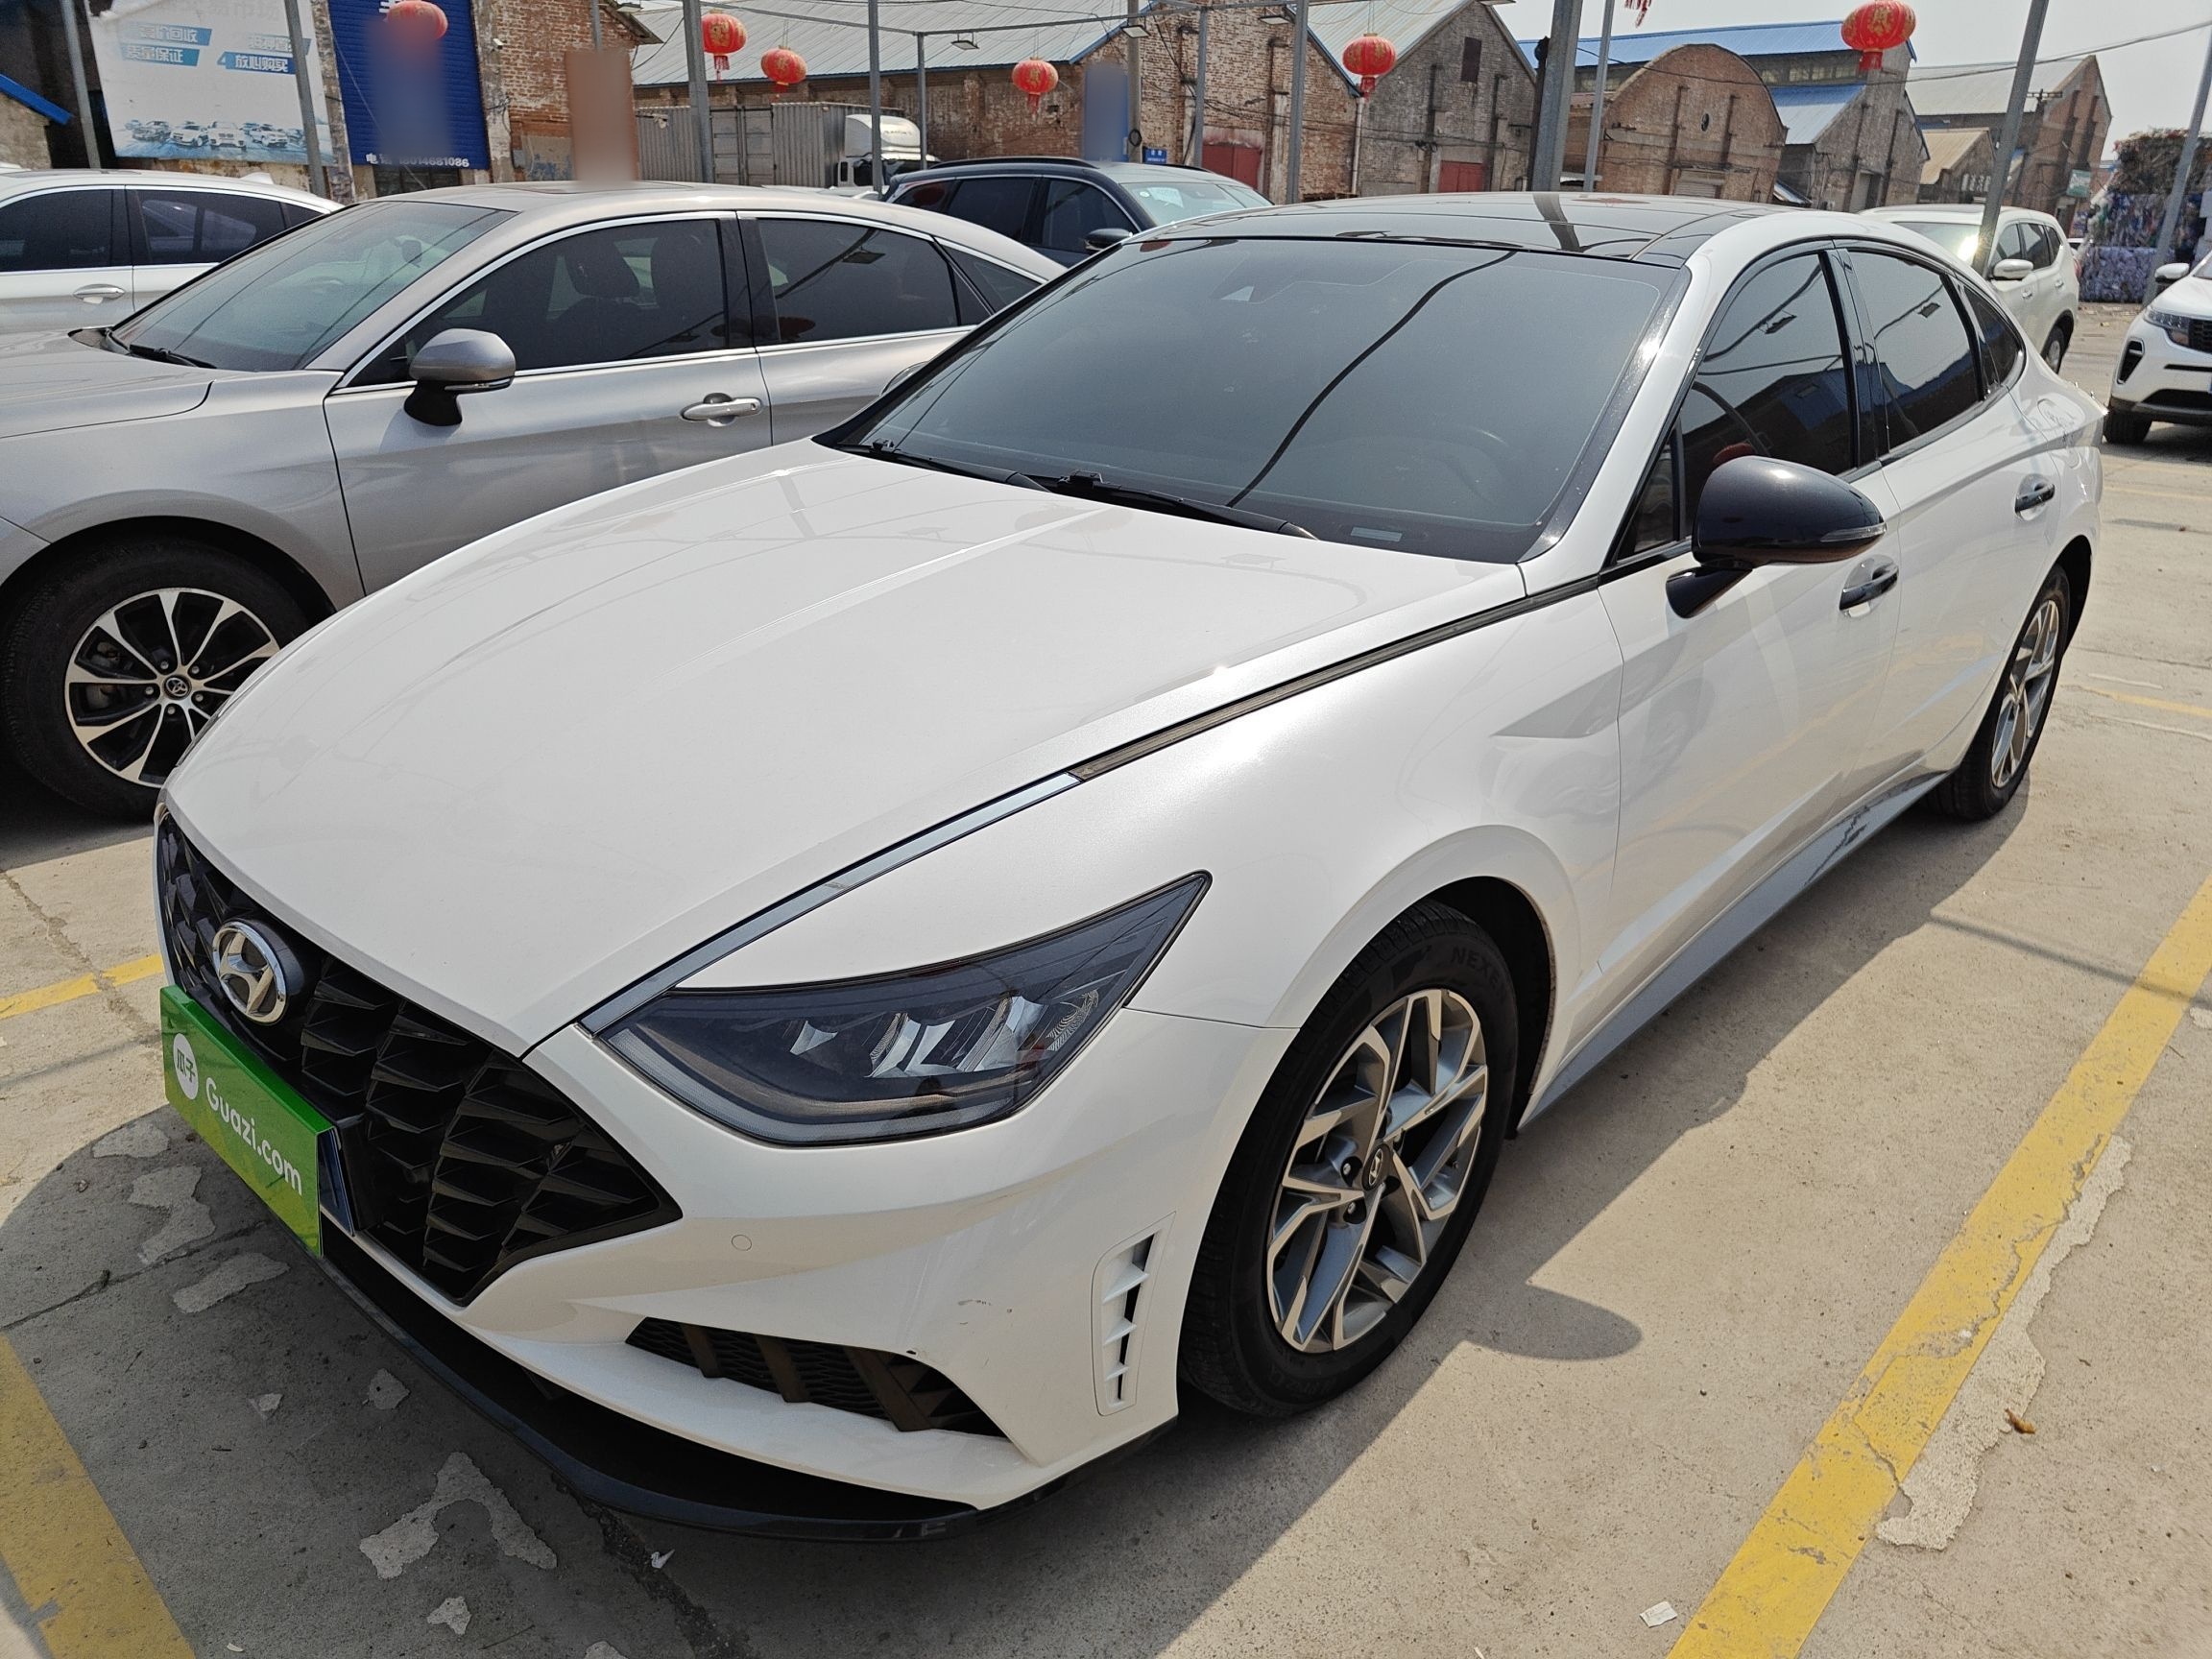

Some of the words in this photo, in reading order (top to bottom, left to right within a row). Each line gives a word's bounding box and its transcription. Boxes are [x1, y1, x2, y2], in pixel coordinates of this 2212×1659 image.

[127, 45, 183, 63] 质量保证
[234, 54, 289, 73] 放心购买
[177, 1047, 196, 1083] 瓜子
[205, 1076, 302, 1197] Guazi.com
